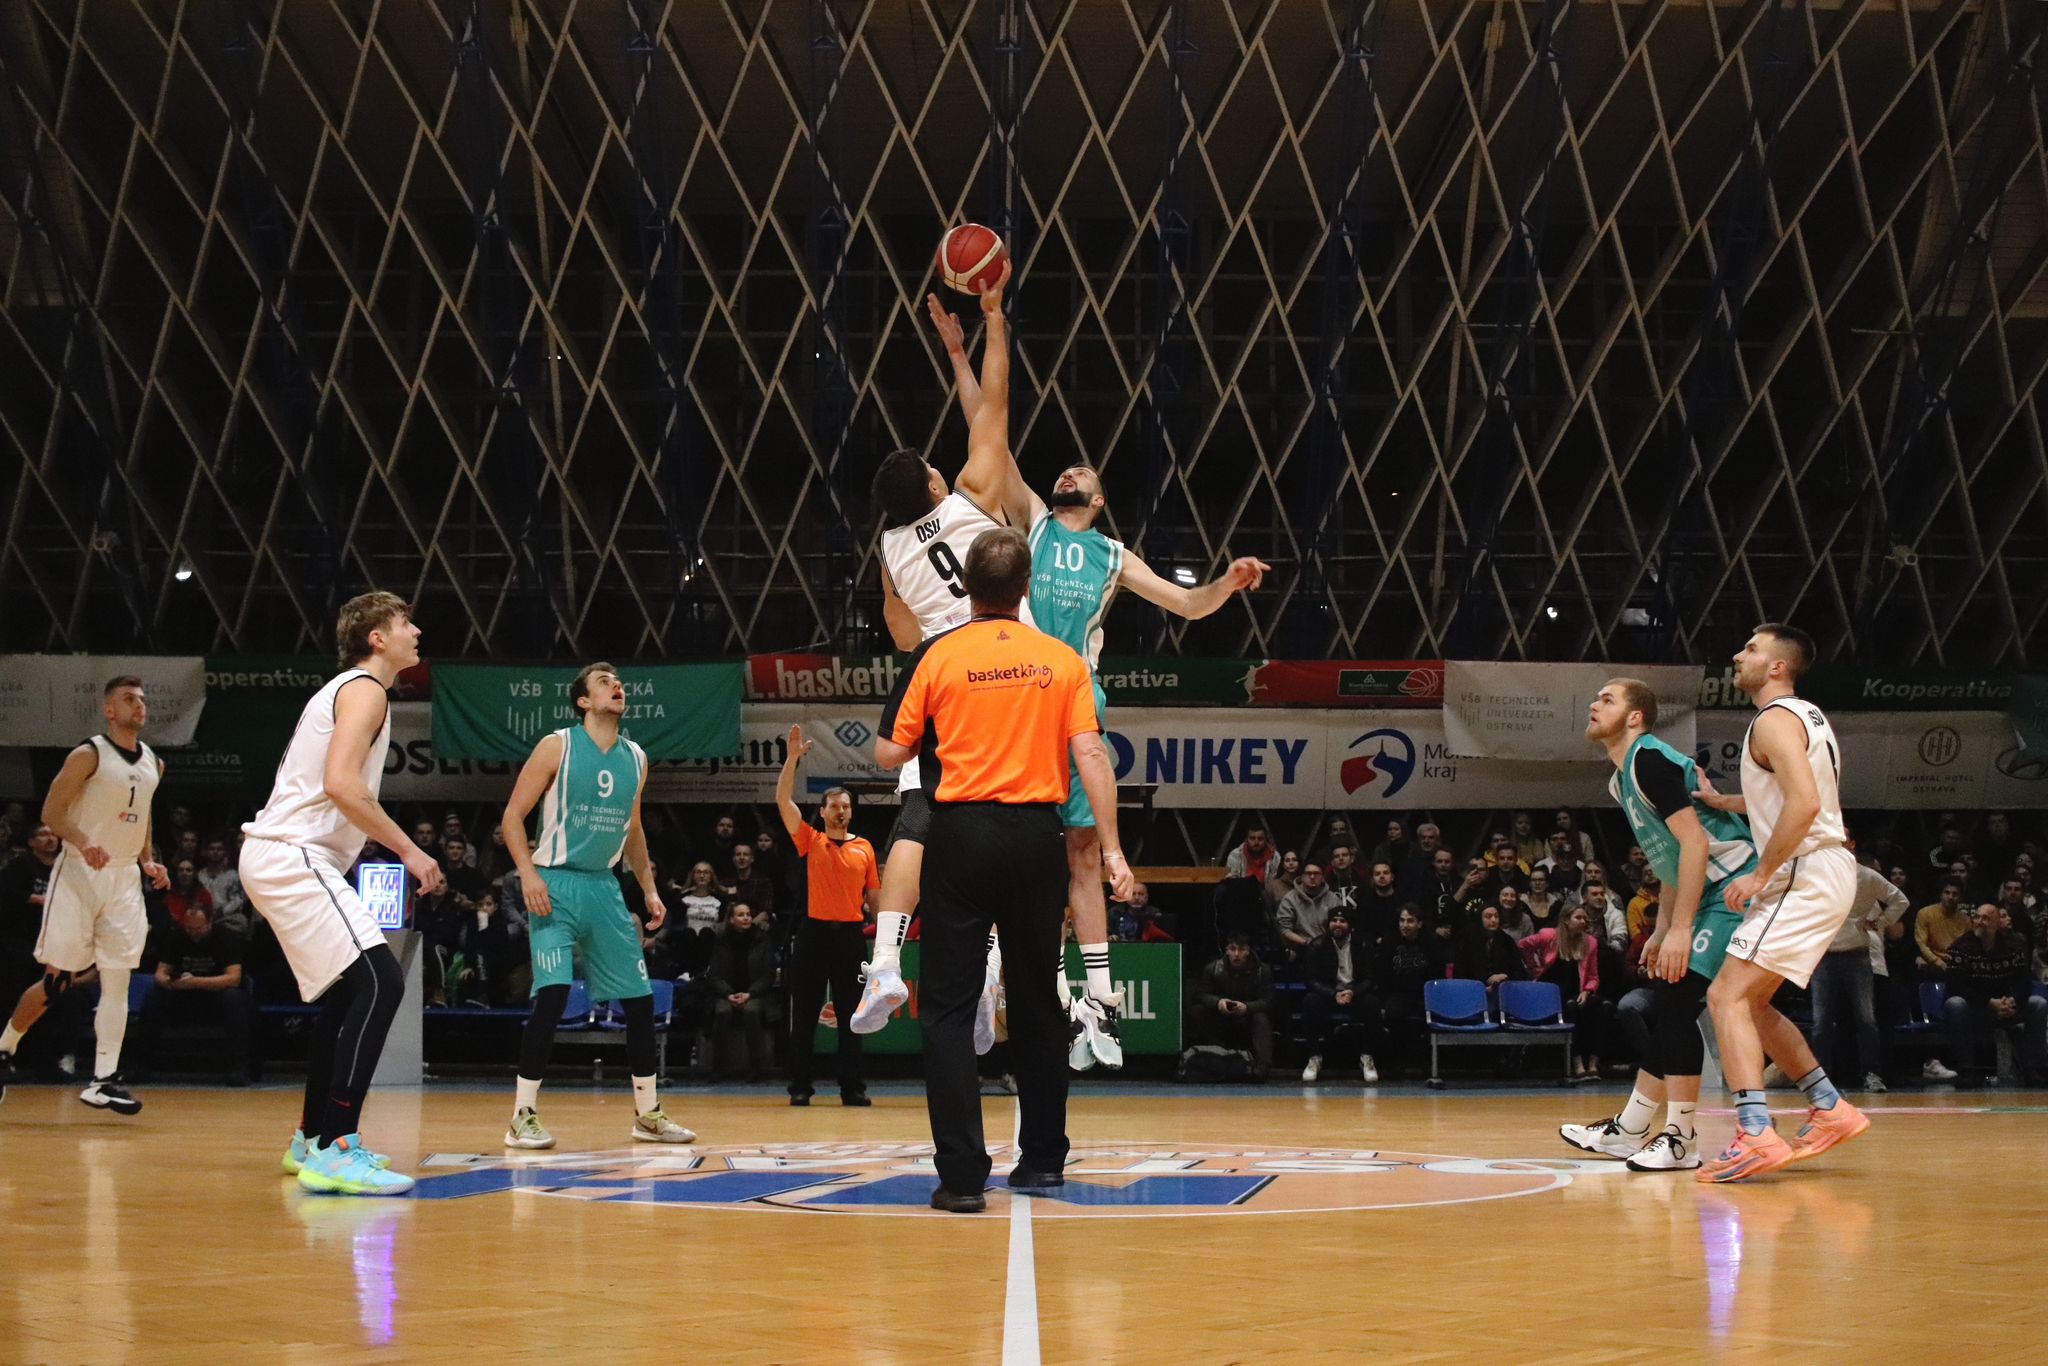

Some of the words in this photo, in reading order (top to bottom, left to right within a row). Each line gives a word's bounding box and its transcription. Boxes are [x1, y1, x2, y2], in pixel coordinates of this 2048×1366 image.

[1053, 541, 1084, 572] 10
[928, 541, 970, 599] 9
[205, 668, 324, 690] operativa
[509, 679, 542, 697] VŠB
[1096, 669, 1179, 688] rativa
[1862, 678, 2013, 701] Kooperativa
[1146, 737, 1309, 784] NIKEY
[1424, 761, 1456, 782] kraj
[597, 769, 614, 798] 9
[128, 785, 135, 807] 1
[1692, 928, 1713, 953] 6
[637, 959, 648, 981] 9
